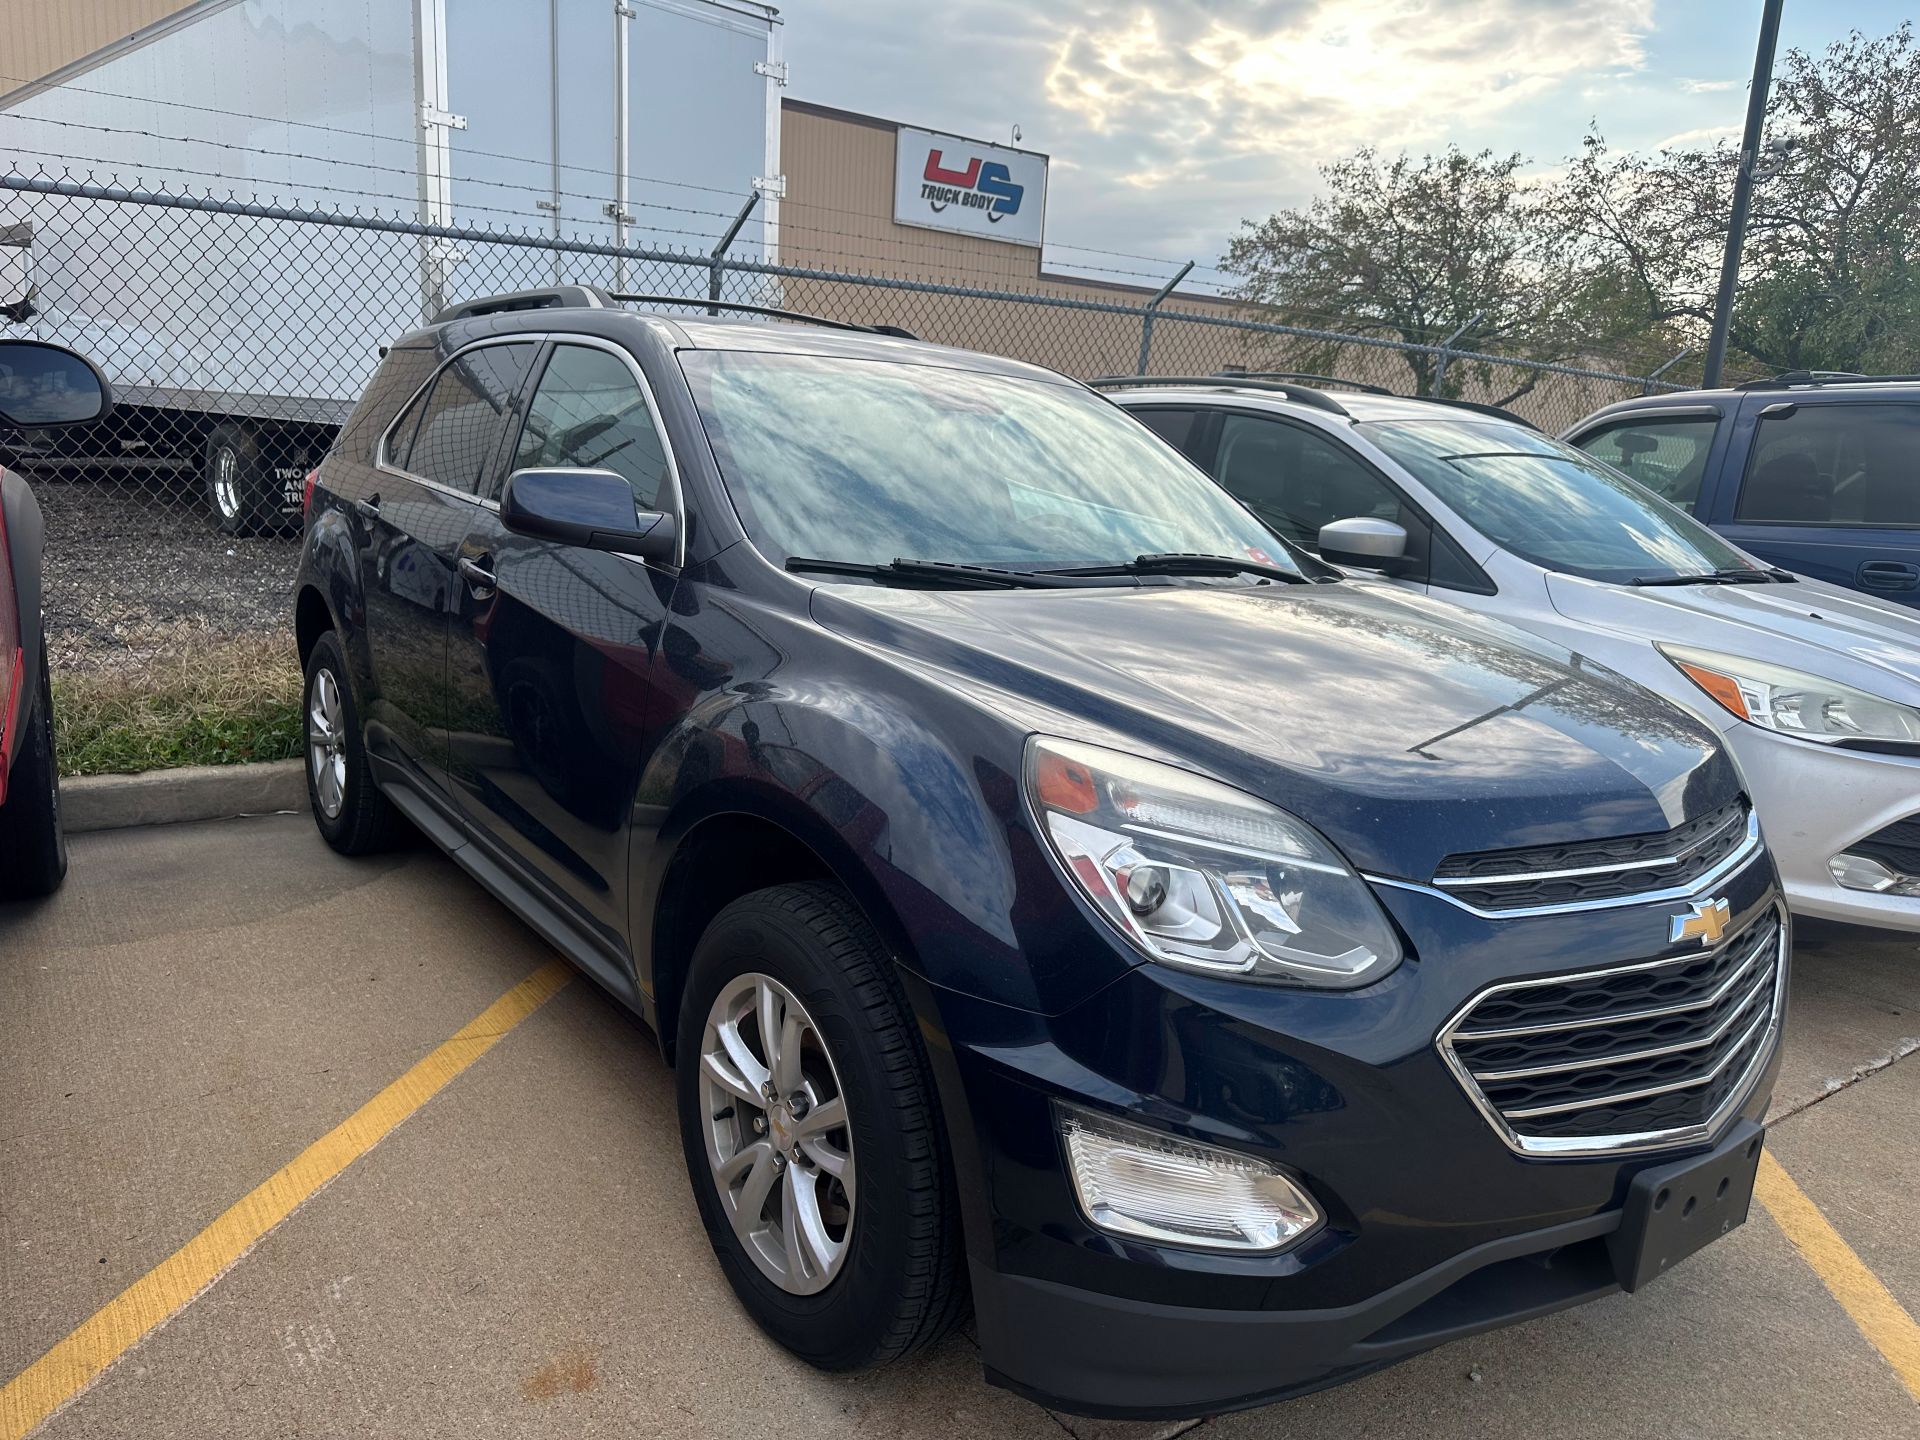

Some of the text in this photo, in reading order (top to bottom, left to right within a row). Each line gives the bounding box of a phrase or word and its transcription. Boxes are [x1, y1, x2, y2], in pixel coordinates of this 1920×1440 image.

[924, 149, 1024, 215] US
[921, 184, 995, 211] TRUCK BODY
[275, 468, 302, 479] TWO
